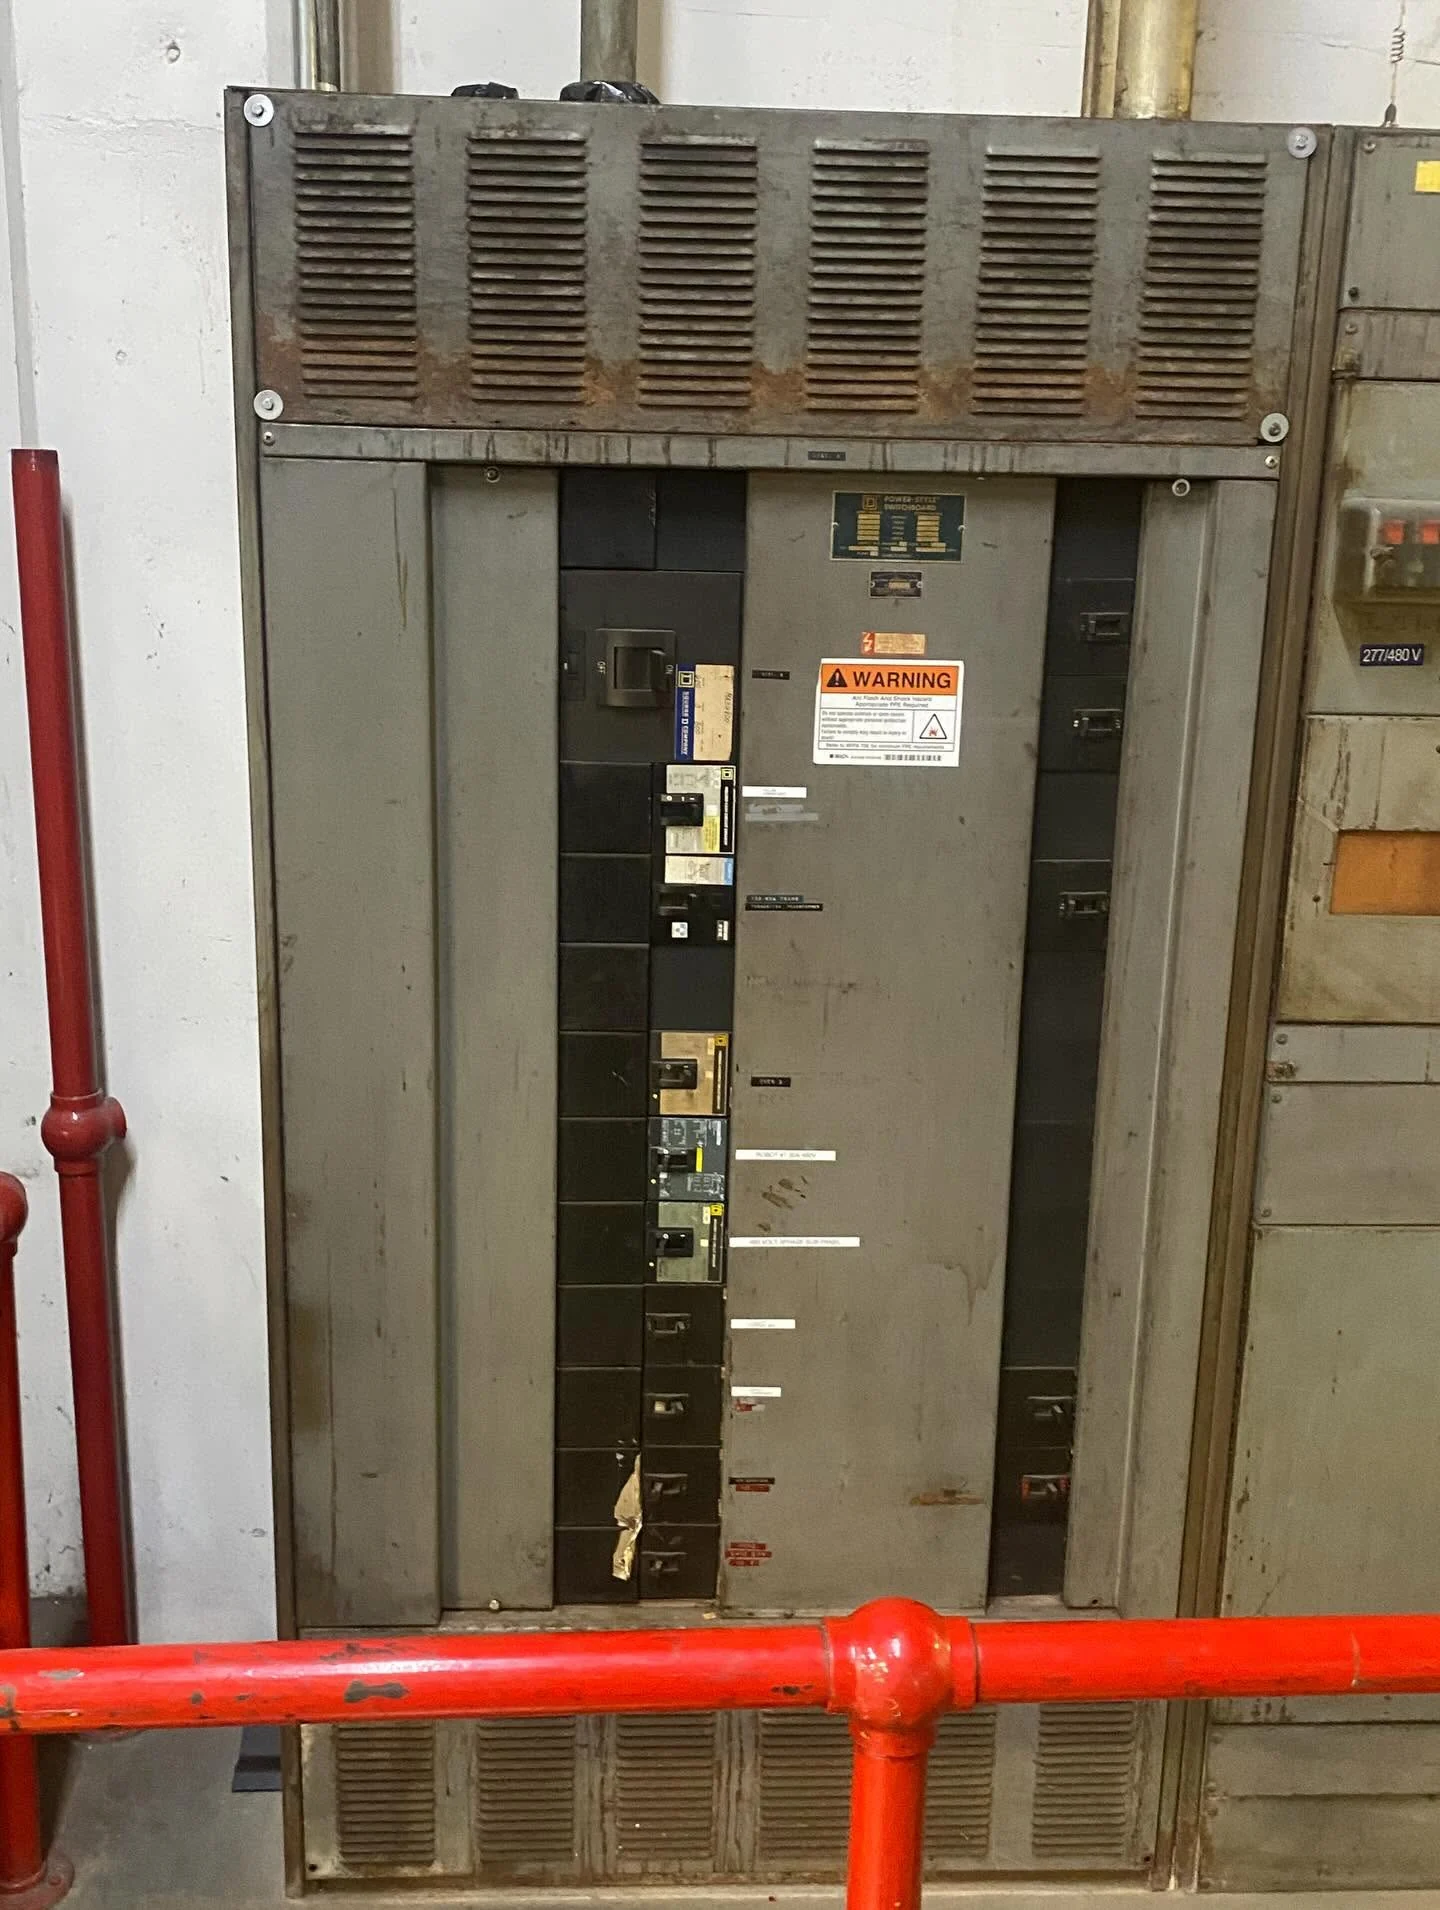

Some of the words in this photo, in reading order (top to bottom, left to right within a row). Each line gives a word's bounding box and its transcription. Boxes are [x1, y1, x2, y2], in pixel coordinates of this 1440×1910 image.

[1363, 648, 1410, 662] 277/480
[1412, 648, 1422, 662] V
[596, 660, 606, 675] OFF
[666, 664, 673, 675] ON
[853, 671, 951, 689] WARNING
[681, 691, 690, 718] SQUARE
[680, 726, 689, 756] COMPANY
